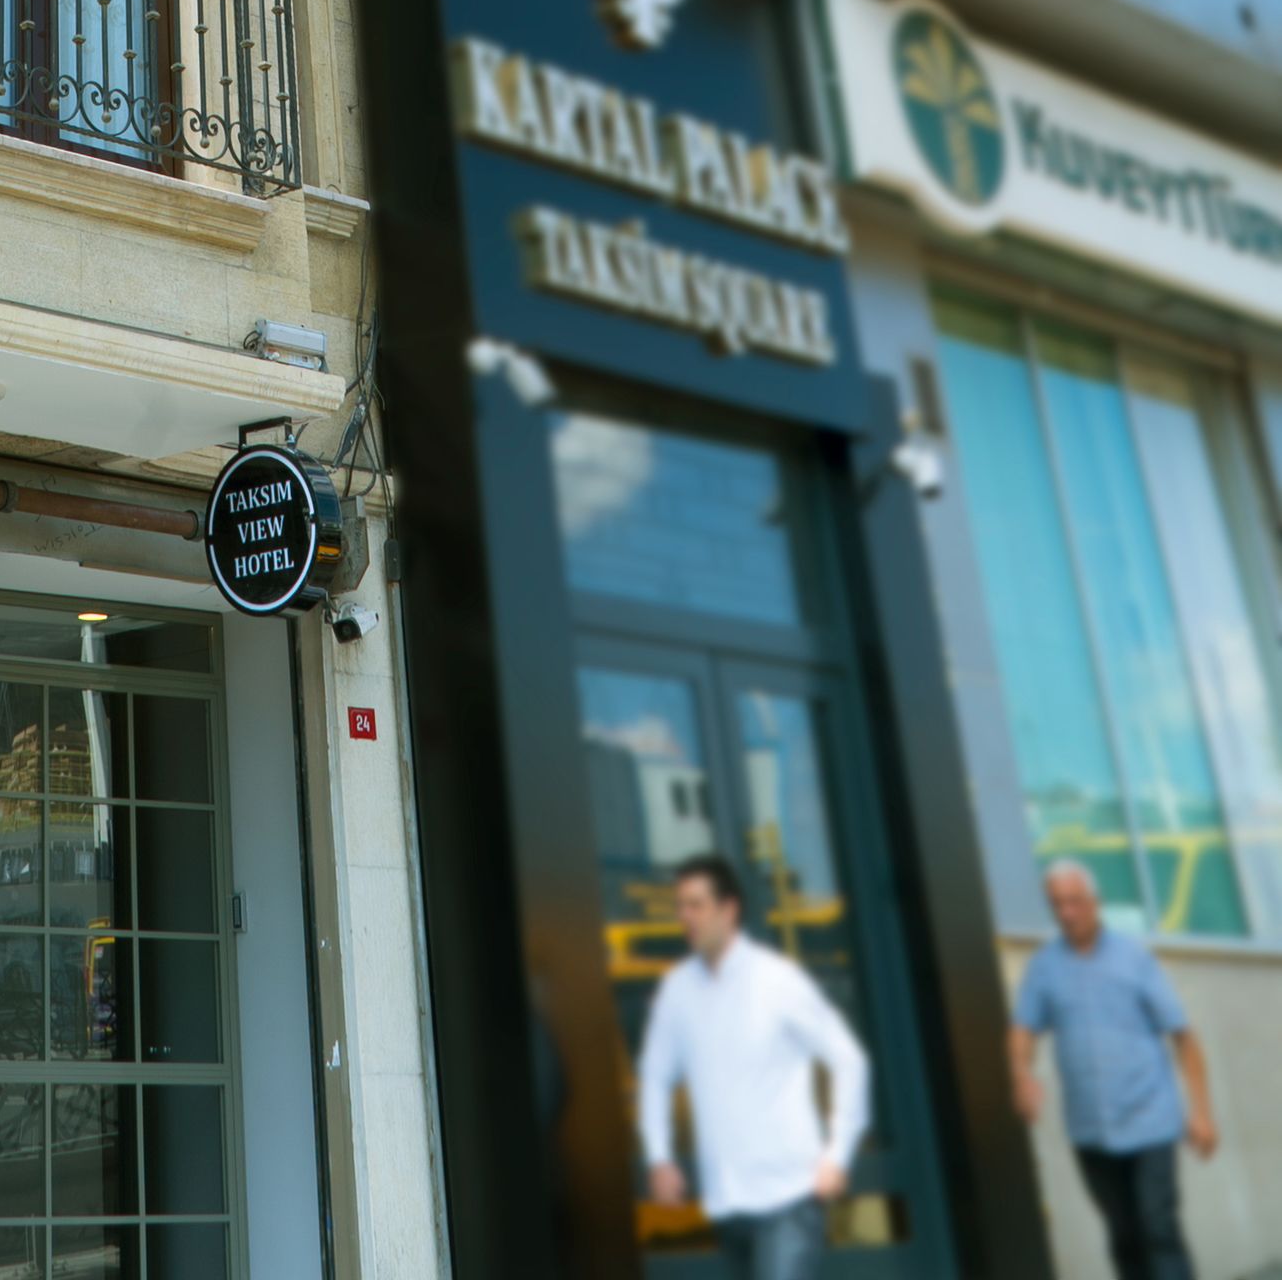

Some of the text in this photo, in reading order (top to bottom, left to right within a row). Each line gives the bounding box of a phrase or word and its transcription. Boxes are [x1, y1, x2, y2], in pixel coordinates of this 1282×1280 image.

[458, 35, 678, 201] KARTAL
[225, 480, 293, 513] TAKSIM
[237, 514, 285, 544] VIEW
[234, 547, 295, 578] HOTEL
[356, 714, 370, 732] 24
